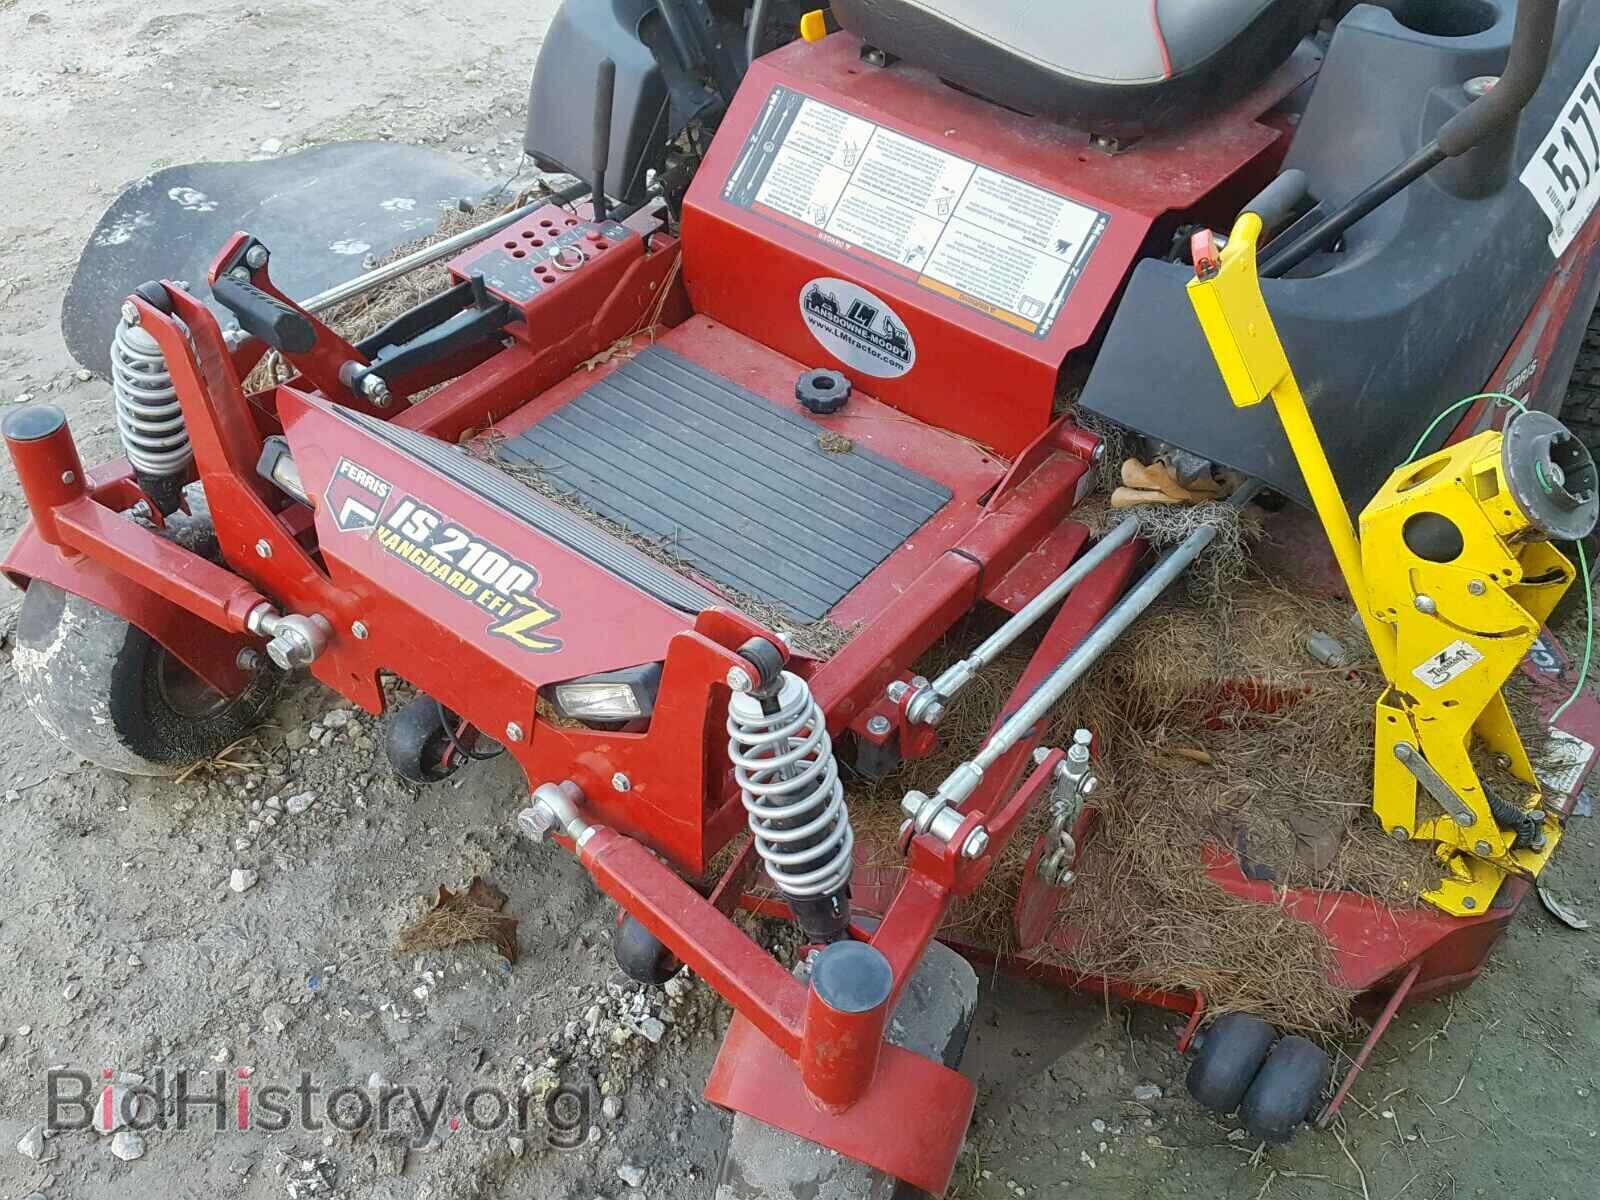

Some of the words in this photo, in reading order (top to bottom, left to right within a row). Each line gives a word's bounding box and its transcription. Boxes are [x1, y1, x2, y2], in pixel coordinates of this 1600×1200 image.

[1542, 66, 1600, 212] 5177
[808, 301, 907, 358] LANSDOWNE-MOODY
[808, 316, 905, 371] www.LMtractor.com
[340, 460, 388, 498] FERRIS
[377, 526, 480, 597] VANGUARD
[476, 588, 513, 617] EFI
[387, 501, 440, 543] IS
[431, 527, 535, 596] 2100
